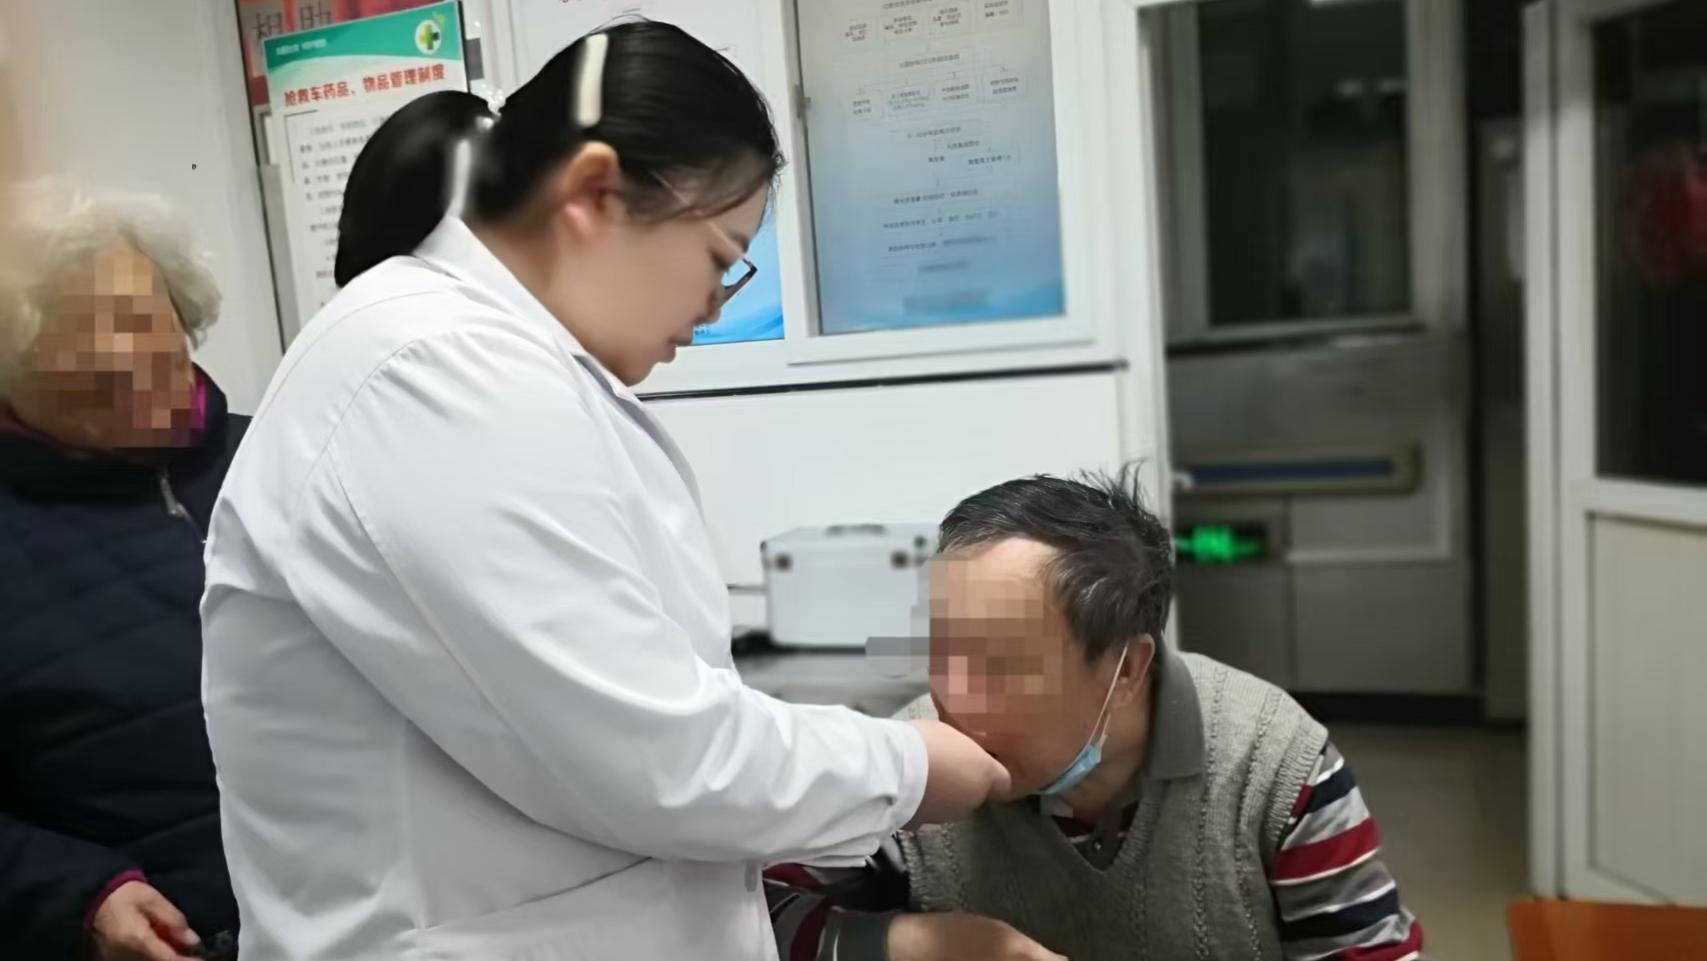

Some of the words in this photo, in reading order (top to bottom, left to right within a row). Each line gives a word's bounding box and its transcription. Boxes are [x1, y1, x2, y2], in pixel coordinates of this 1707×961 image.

[284, 63, 446, 106] 抢救车药品、物品管理制度
